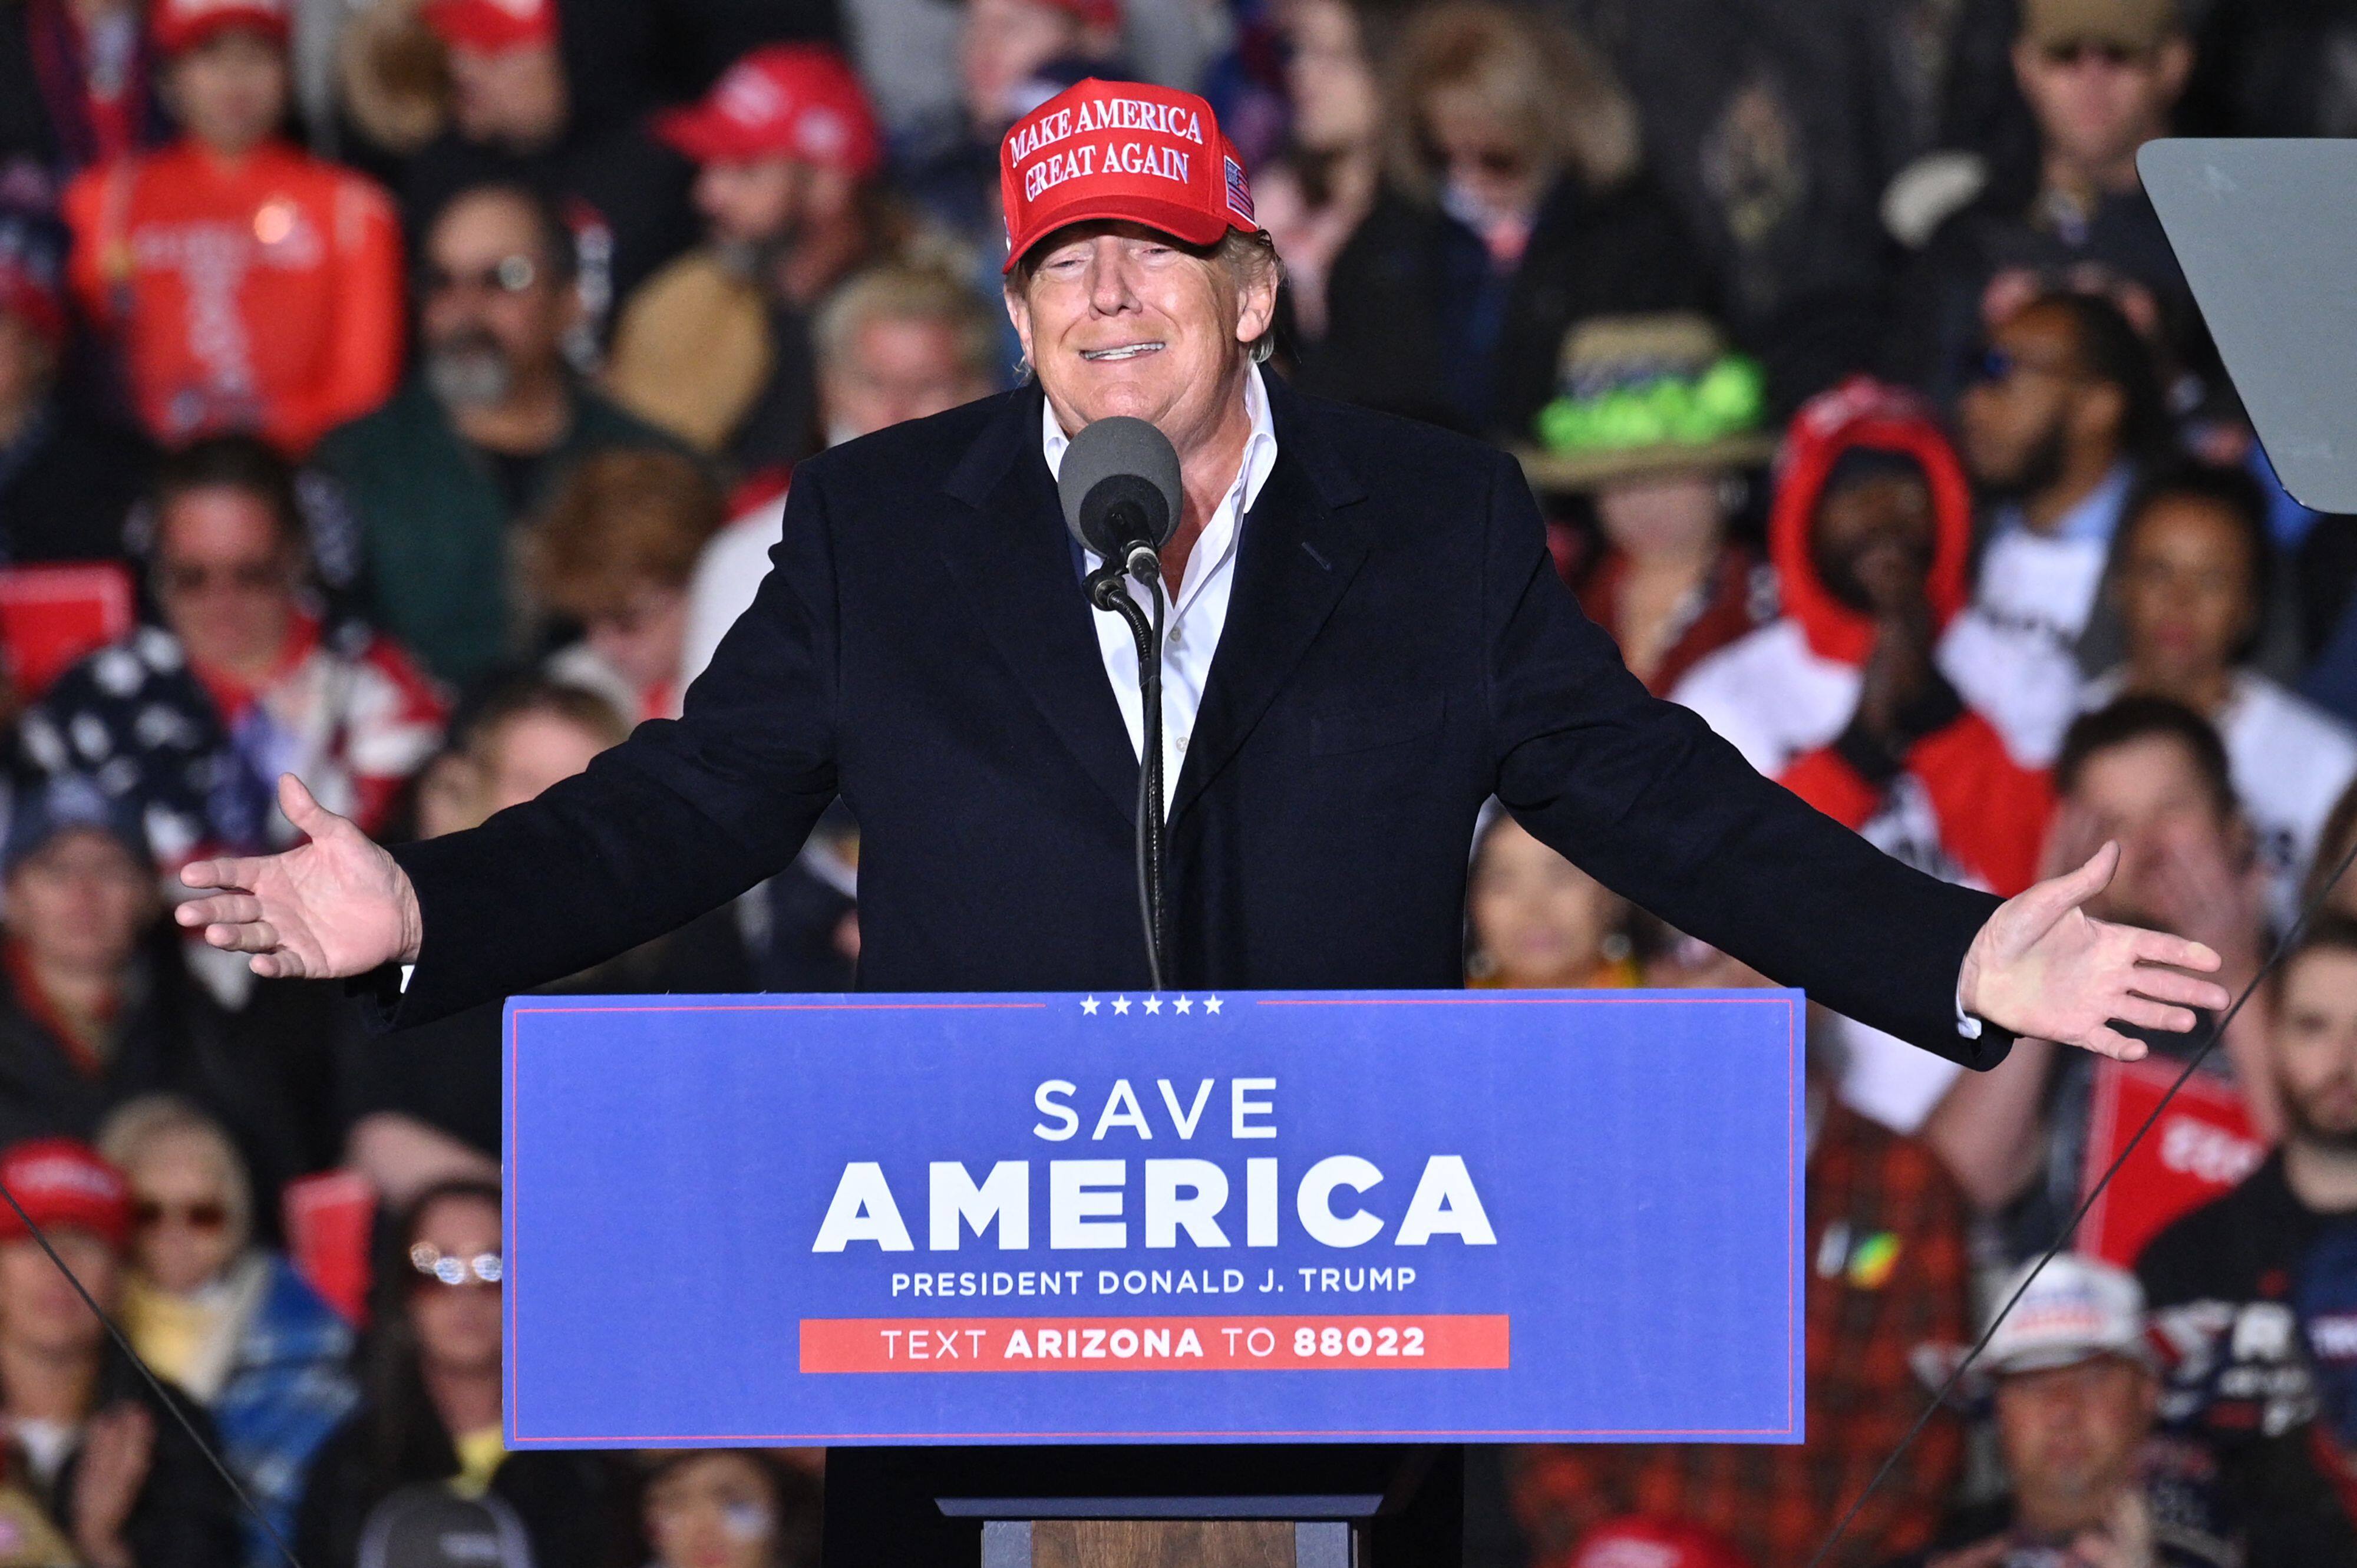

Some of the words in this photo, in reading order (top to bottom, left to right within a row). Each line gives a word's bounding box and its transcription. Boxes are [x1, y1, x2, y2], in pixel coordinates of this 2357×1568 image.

[1009, 108, 1072, 169] MAKE
[1074, 98, 1204, 145] AMERICA
[1025, 144, 1097, 203] GREAT
[1101, 142, 1190, 184] AGAIN
[1033, 1078, 1278, 1142] SAVE
[811, 1154, 1498, 1253] AMERICA
[892, 1271, 1084, 1298] PRESIDENT
[1098, 1269, 1245, 1295] DONALD
[1259, 1269, 1285, 1293] J.
[1298, 1267, 1417, 1293] TRUMP
[880, 1329, 988, 1360] TEXT
[1003, 1328, 1205, 1359] ARIZONA
[1221, 1327, 1276, 1358] TO
[1293, 1326, 1425, 1358] 88022
